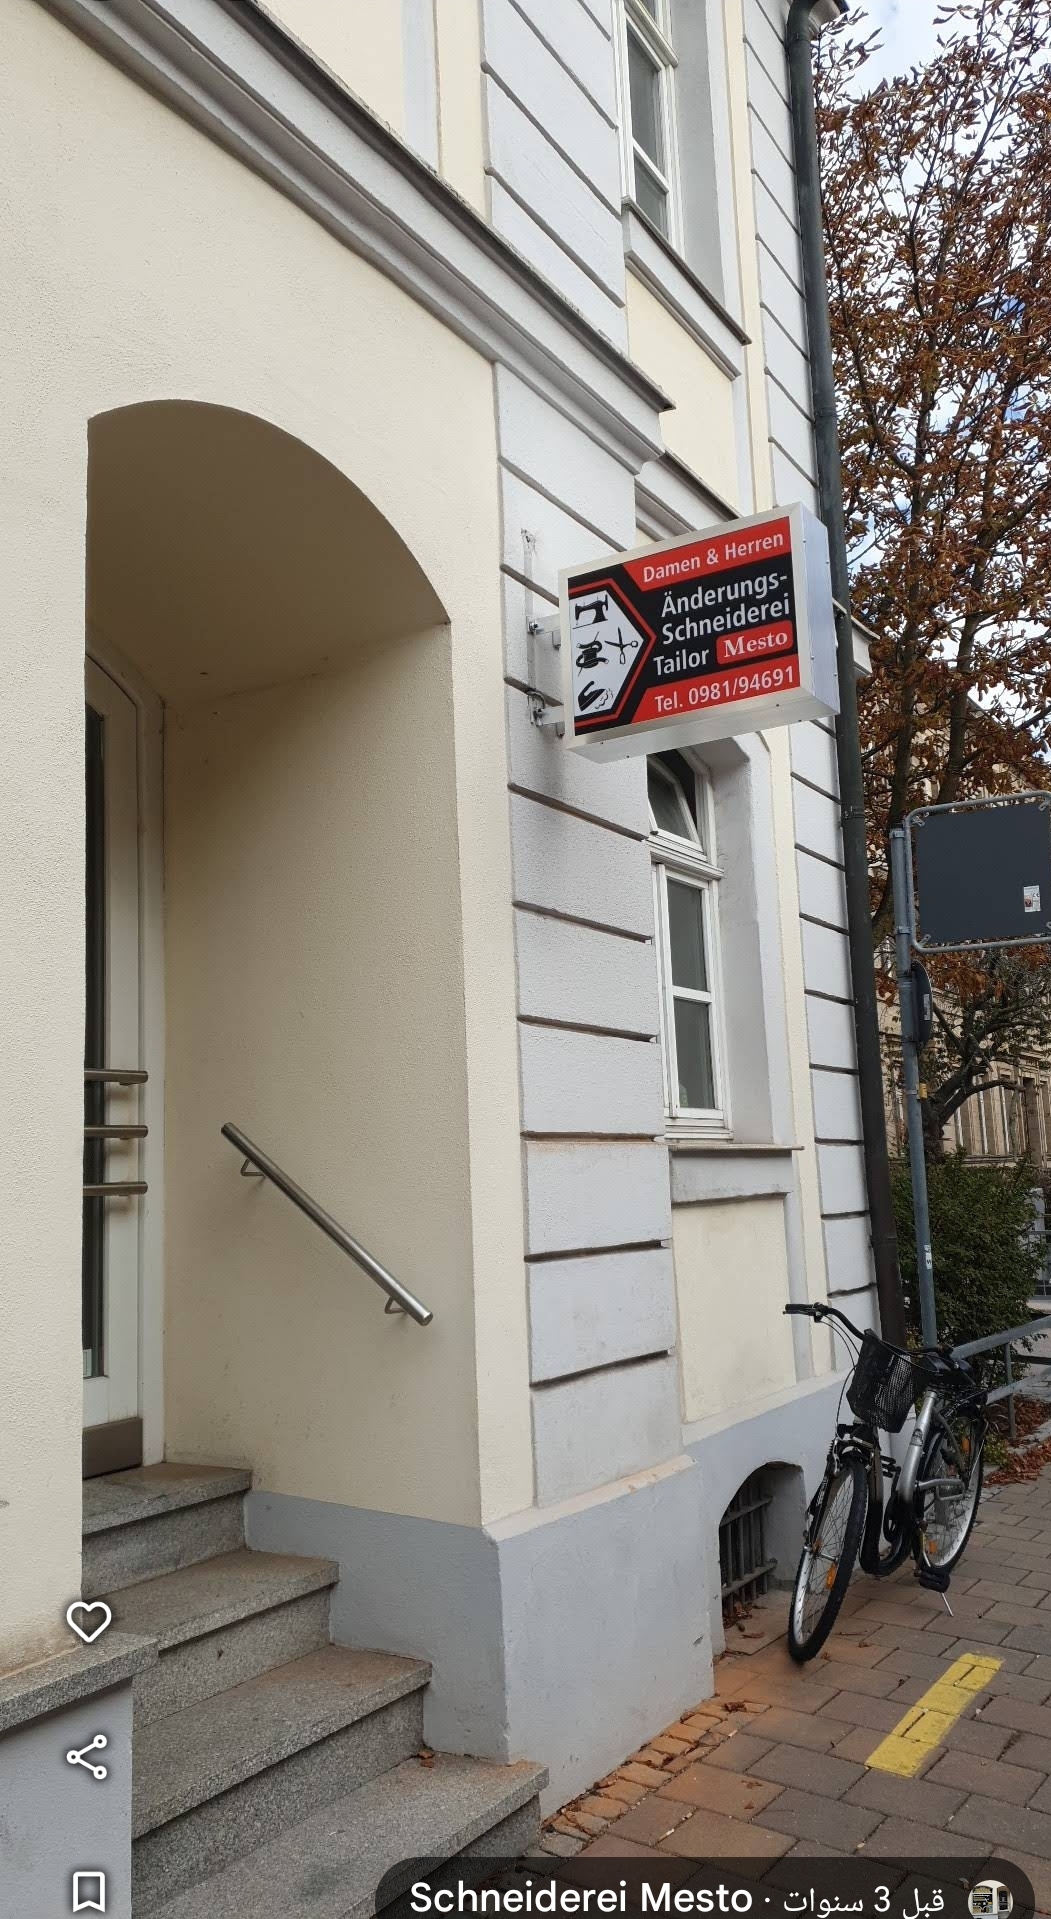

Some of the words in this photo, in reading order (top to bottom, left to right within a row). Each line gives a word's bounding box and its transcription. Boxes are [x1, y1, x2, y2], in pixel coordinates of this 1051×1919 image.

[643, 554, 700, 583] Damen
[706, 548, 719, 565] &
[725, 533, 784, 561] Herren
[661, 572, 788, 618] Änderungs-
[662, 593, 790, 645] Schneiderei
[653, 648, 709, 676] Tailor
[723, 632, 788, 658] Mesto
[655, 691, 683, 713] Tel.
[688, 665, 794, 705] 0981/94691
